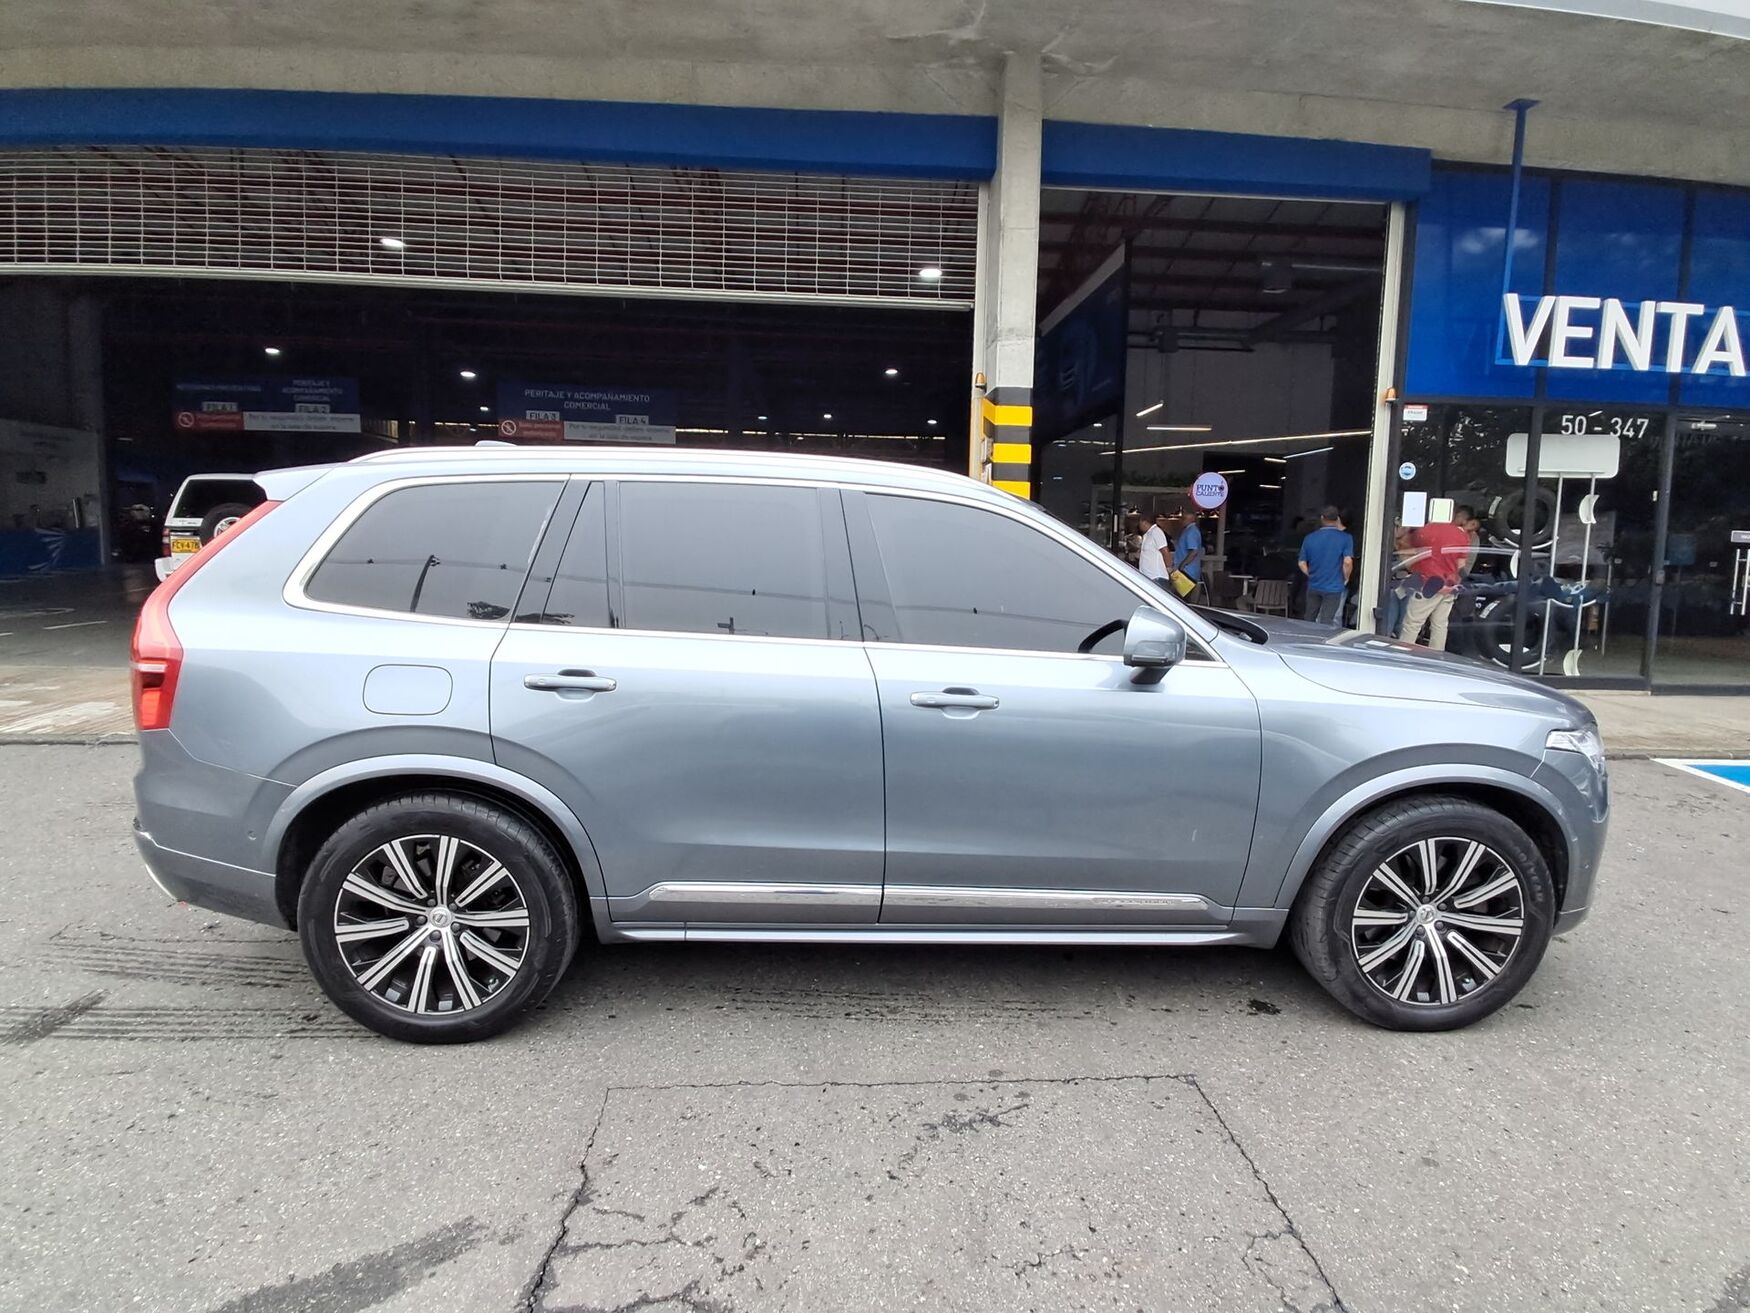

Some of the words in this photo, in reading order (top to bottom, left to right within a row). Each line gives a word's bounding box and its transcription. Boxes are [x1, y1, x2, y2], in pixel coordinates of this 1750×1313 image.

[1503, 293, 1746, 377] VENTA
[524, 388, 565, 399] PERITAJE
[567, 391, 573, 399] Y
[564, 400, 611, 411] COMERCIAL
[529, 412, 549, 420] FILA
[619, 416, 639, 424] FILA
[1561, 415, 1587, 435] 50
[1610, 416, 1650, 439] 347
